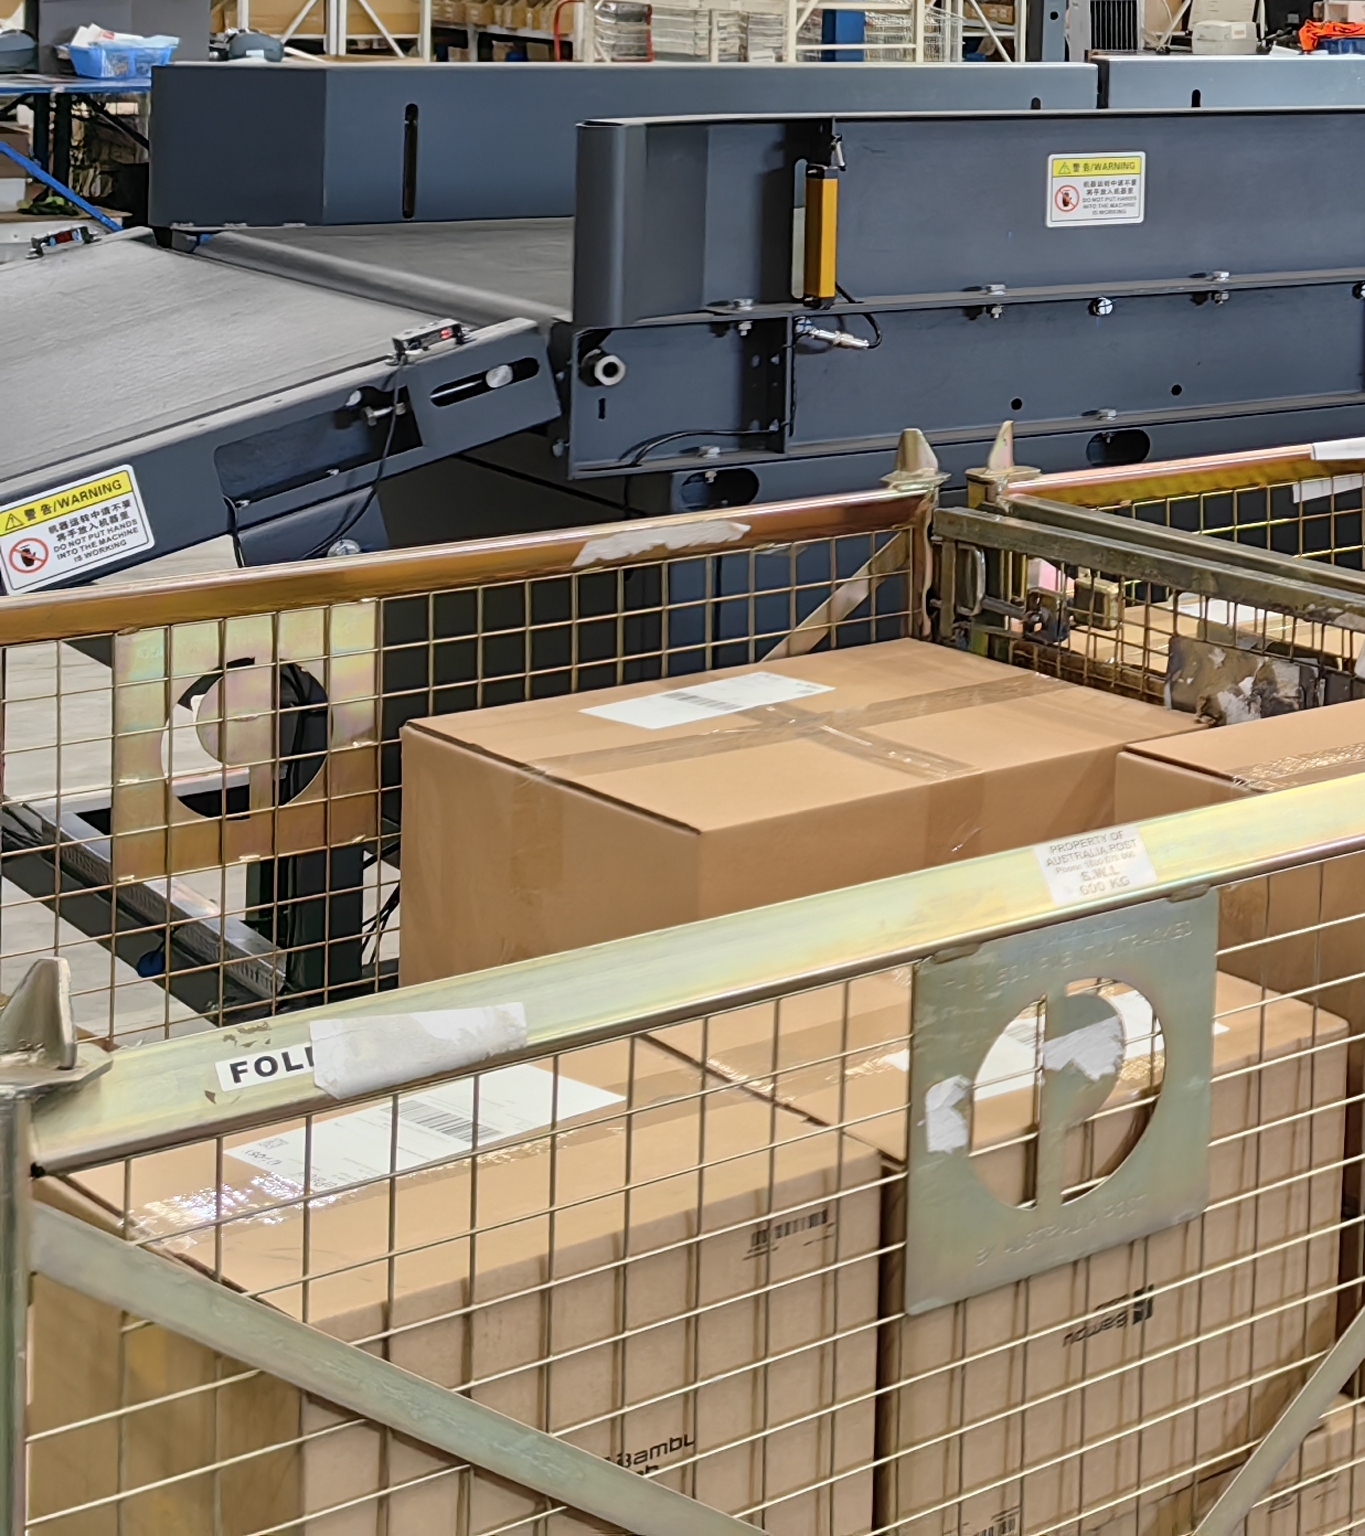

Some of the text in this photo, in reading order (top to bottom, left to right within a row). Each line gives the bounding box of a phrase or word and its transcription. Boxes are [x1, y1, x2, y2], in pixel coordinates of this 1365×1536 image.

[54, 519, 138, 553] DO NOT PUT HANDS
[57, 527, 139, 560] INTO THE MACHINE
[85, 539, 128, 559] WORKING
[1046, 845, 1107, 866] AUSTRALIA
[1109, 839, 1138, 852] POST
[1049, 830, 1124, 854] PROPERTY OF
[1110, 875, 1131, 889] KG
[230, 1045, 314, 1084] FOL
